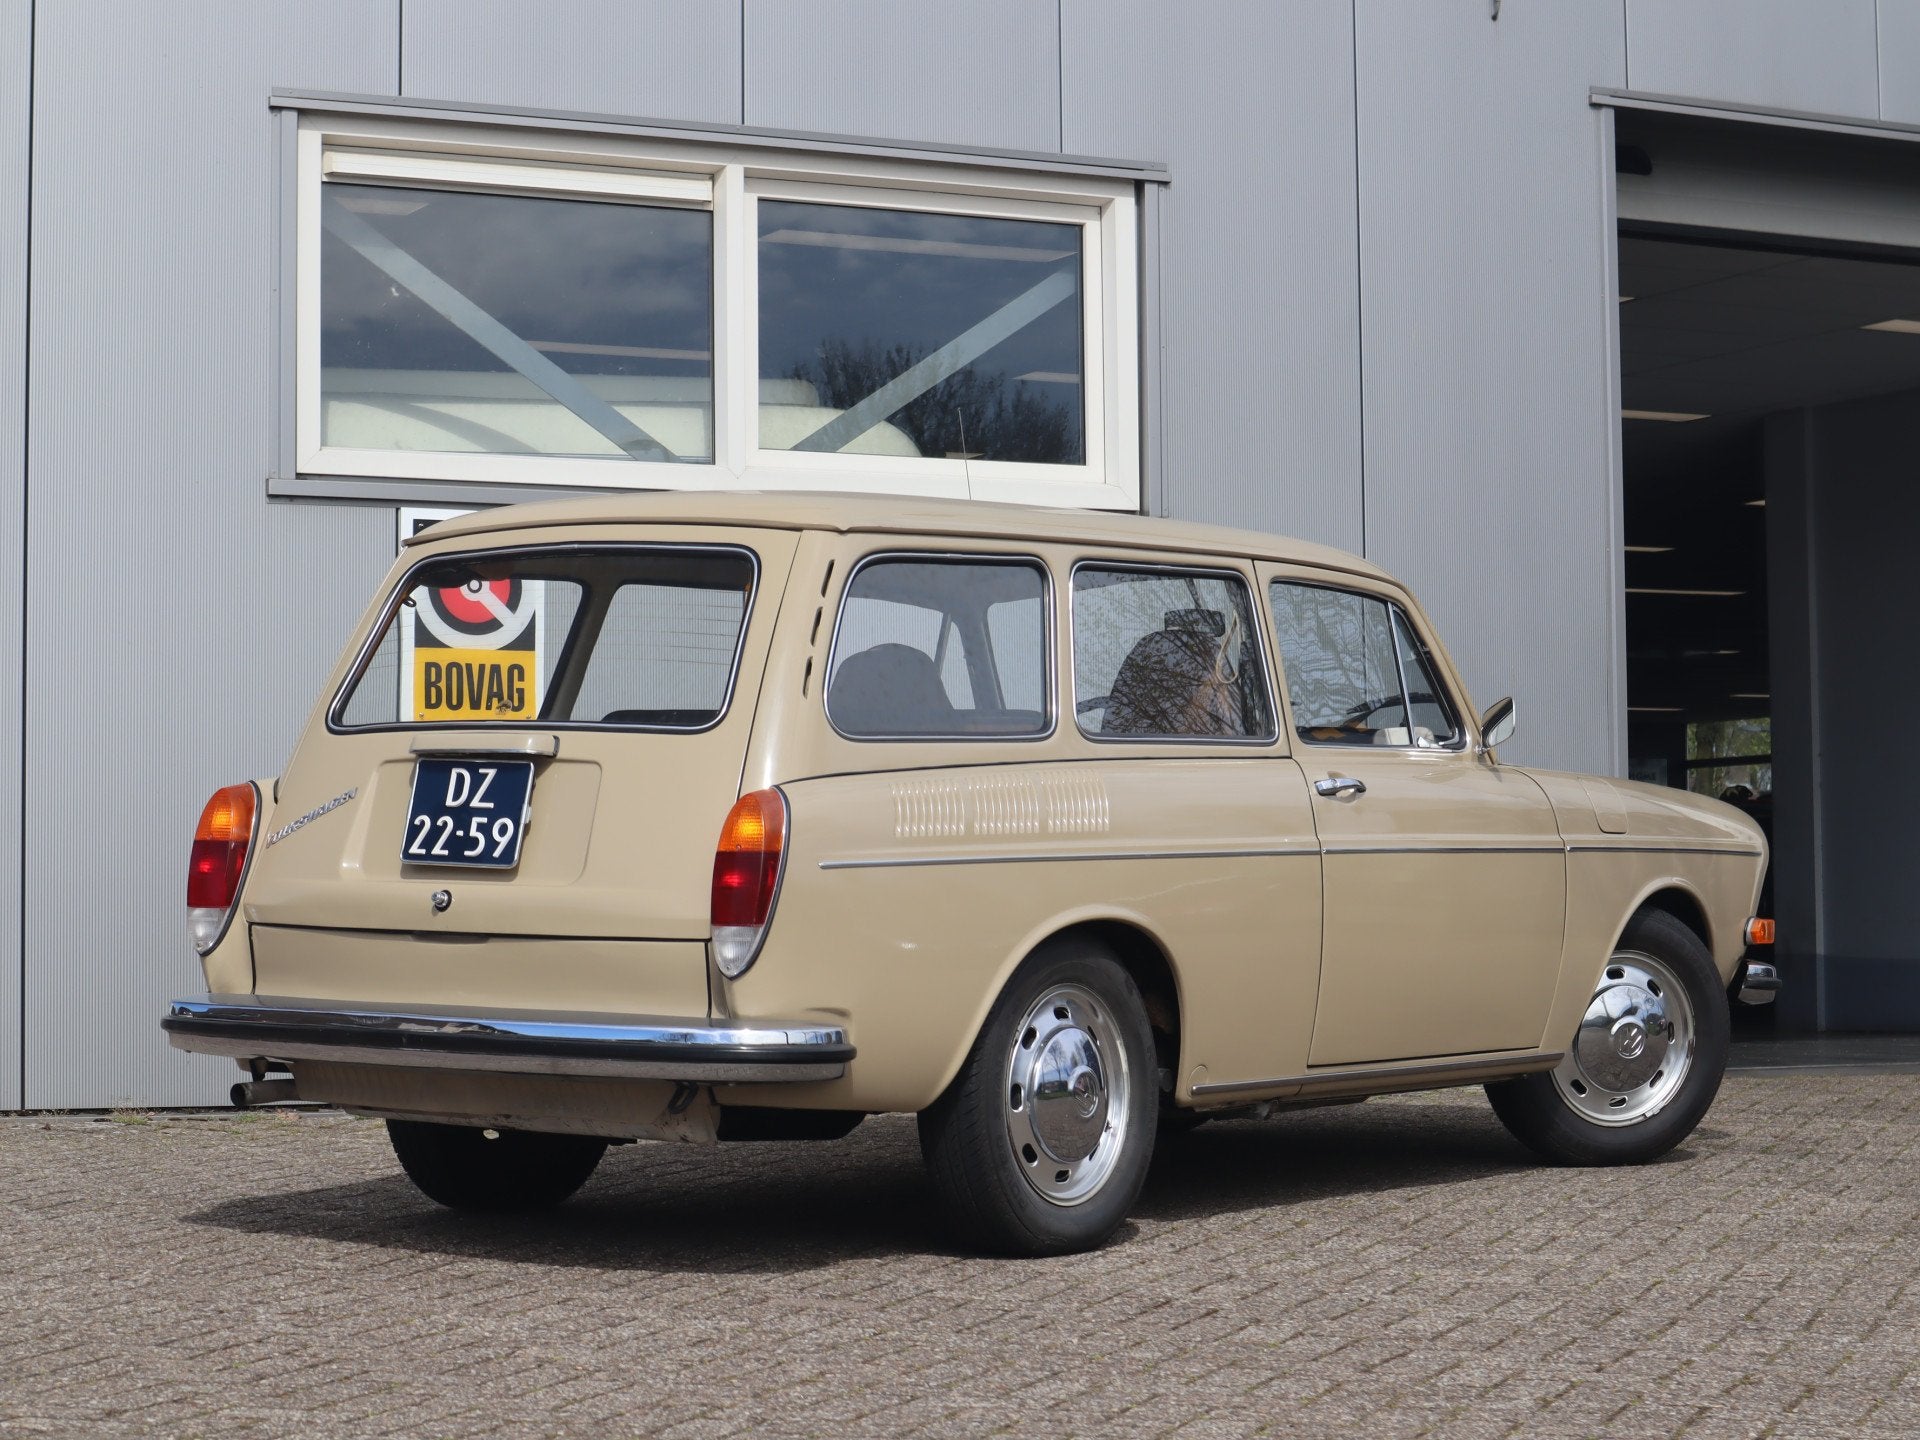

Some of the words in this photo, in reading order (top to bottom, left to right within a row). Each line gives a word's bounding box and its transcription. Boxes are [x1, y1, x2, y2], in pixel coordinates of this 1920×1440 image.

[424, 661, 525, 712] BOVAG
[446, 767, 498, 809] DZ
[408, 815, 514, 858] 22-59
